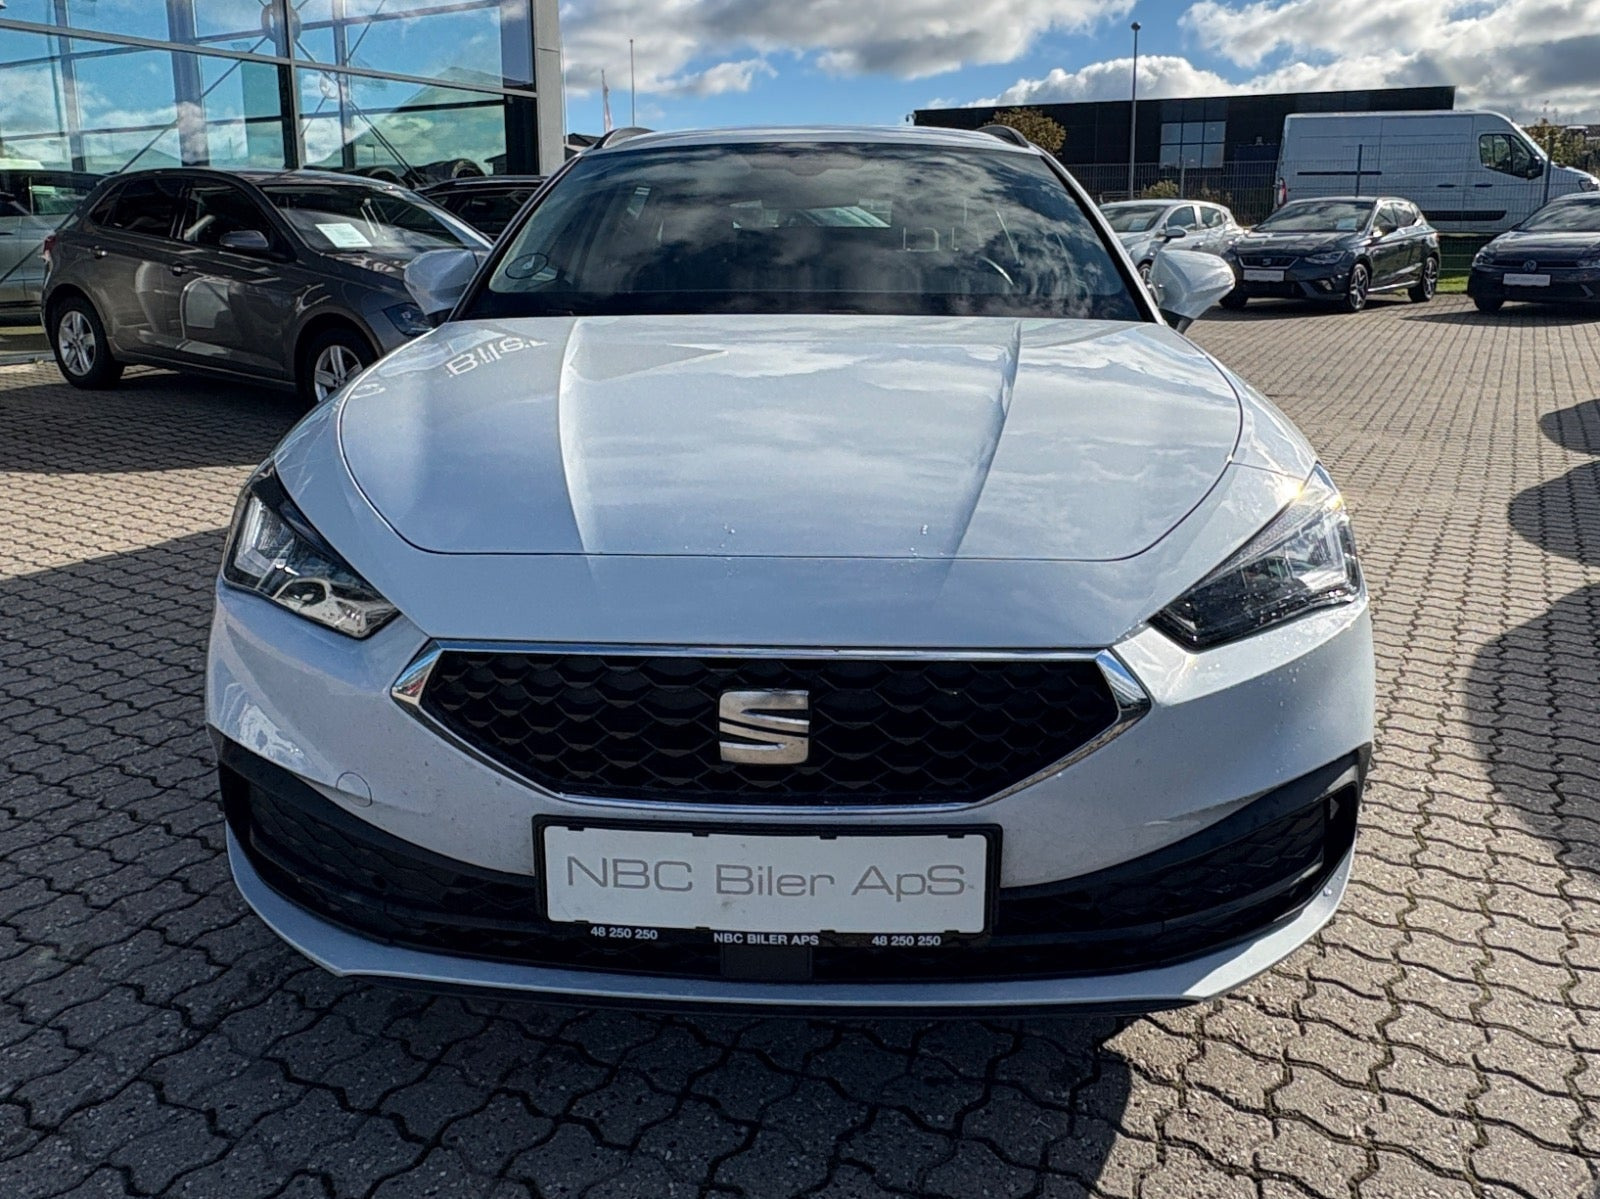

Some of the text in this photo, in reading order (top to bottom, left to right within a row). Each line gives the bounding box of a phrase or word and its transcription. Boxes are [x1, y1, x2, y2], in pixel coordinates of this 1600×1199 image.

[567, 855, 965, 902] NBC Biler ApS
[590, 926, 658, 940] 48 250 250
[713, 932, 820, 946] NBC BILER APS
[871, 935, 942, 946] 48 250 250
